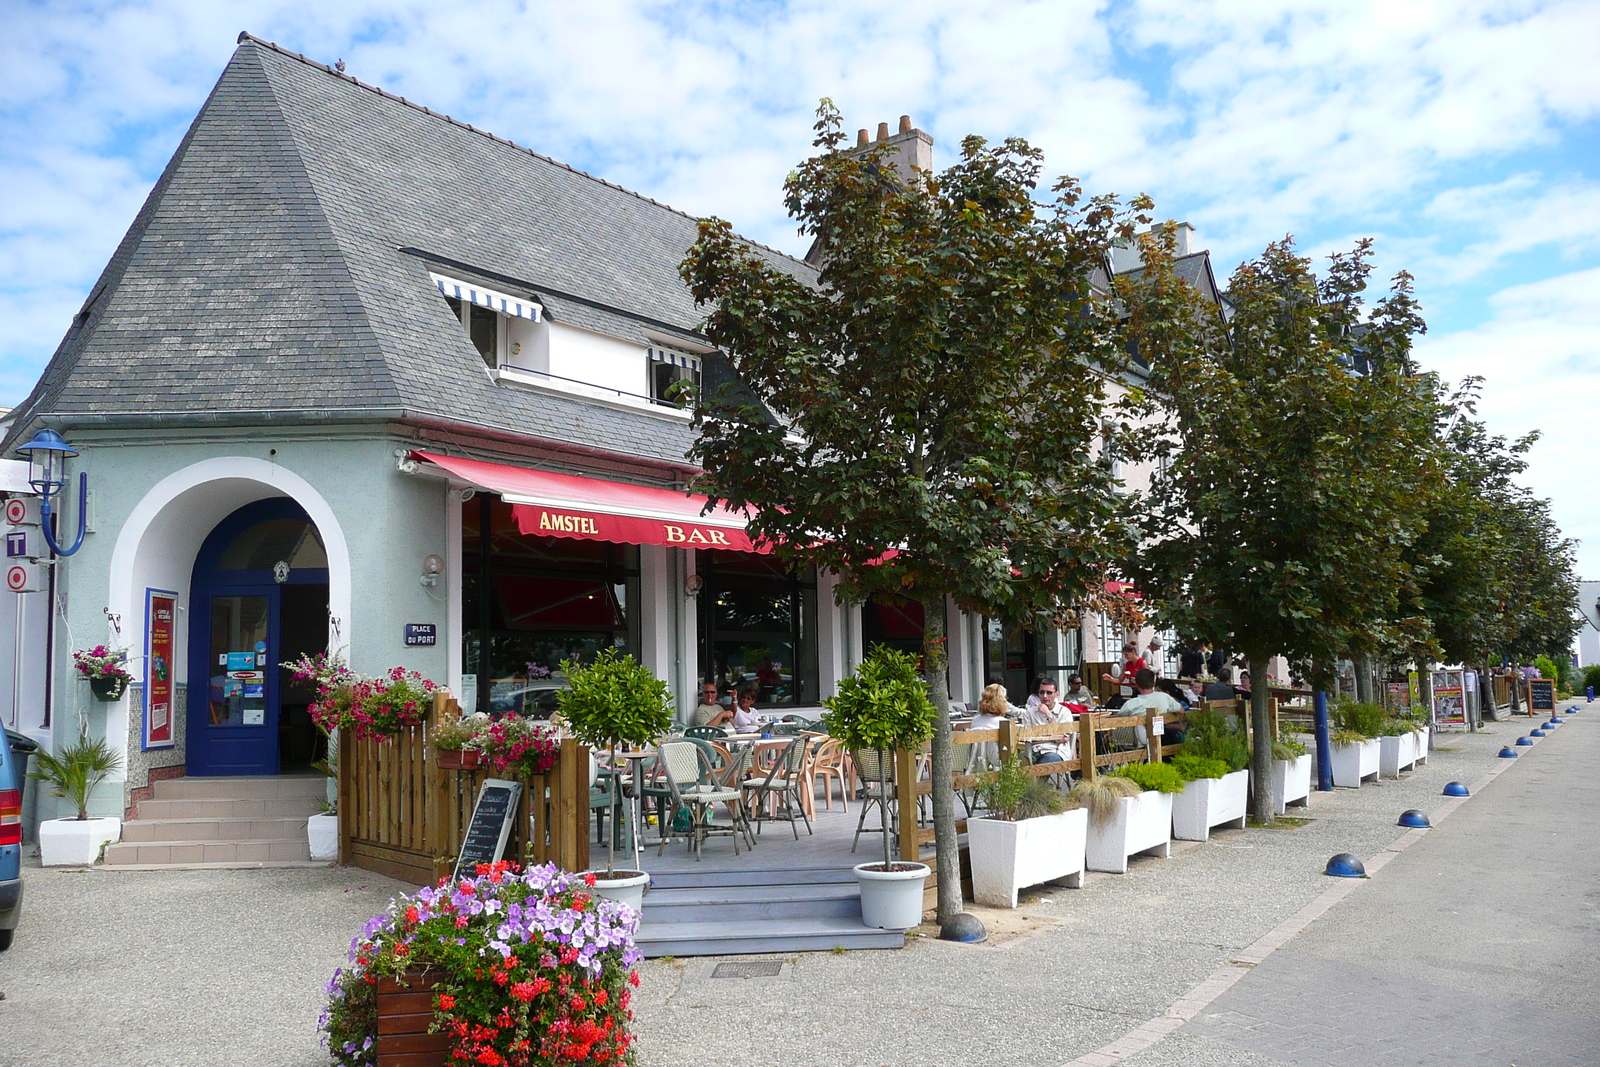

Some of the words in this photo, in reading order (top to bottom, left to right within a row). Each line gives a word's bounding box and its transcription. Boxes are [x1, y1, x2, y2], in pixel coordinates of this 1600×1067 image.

[539, 511, 599, 535] AMSTEL
[663, 525, 731, 545] BAR
[412, 625, 431, 633] PLACE
[417, 635, 435, 644] PORT
